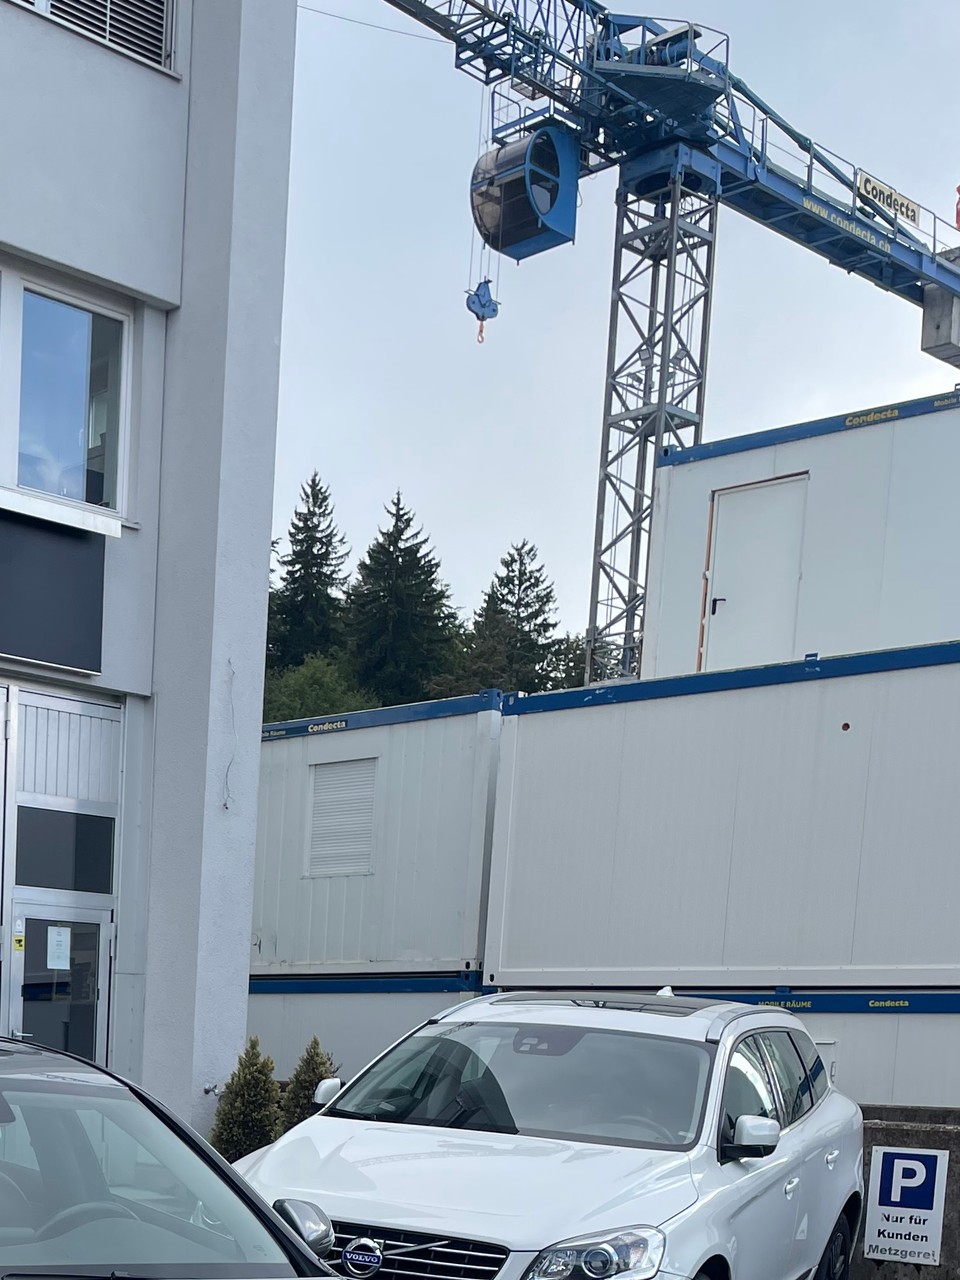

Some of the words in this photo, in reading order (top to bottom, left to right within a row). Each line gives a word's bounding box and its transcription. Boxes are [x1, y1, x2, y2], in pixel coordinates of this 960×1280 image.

[863, 177, 917, 223] Condecta
[845, 409, 900, 426] Condecta
[307, 720, 347, 733] Condecta
[786, 1000, 813, 1008] RÄUME
[868, 999, 910, 1008] Condecta
[890, 1158, 927, 1203] P
[881, 1212, 906, 1224] Nur
[908, 1214, 929, 1226] für
[877, 1228, 929, 1242] Kunden
[344, 1251, 379, 1263] VOLVO
